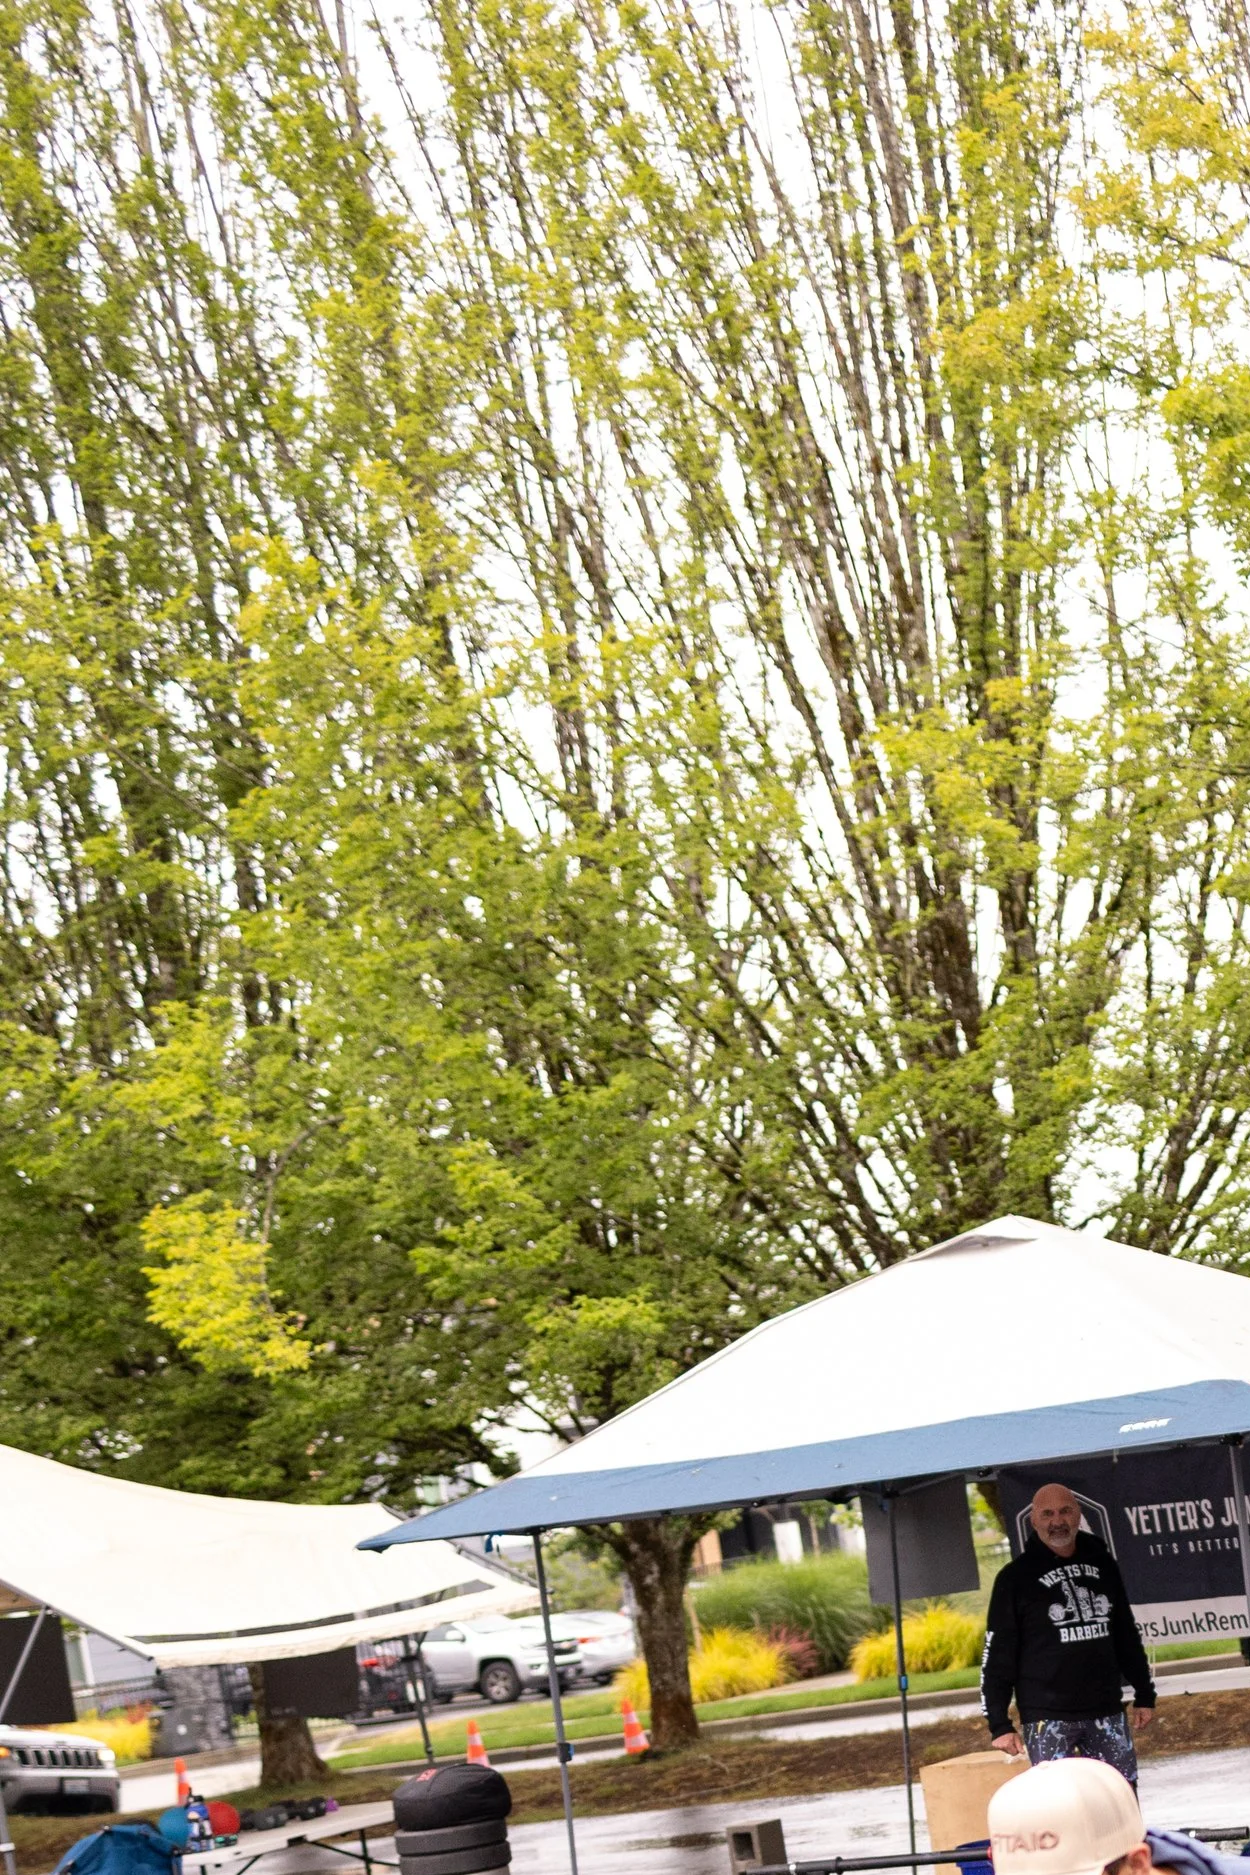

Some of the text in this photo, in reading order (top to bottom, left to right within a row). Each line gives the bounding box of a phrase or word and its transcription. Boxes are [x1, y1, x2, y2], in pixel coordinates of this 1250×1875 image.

[1123, 1498, 1215, 1535] YETTER'S
[1150, 1542, 1179, 1556] IT'S
[1188, 1539, 1239, 1553] BETTER
